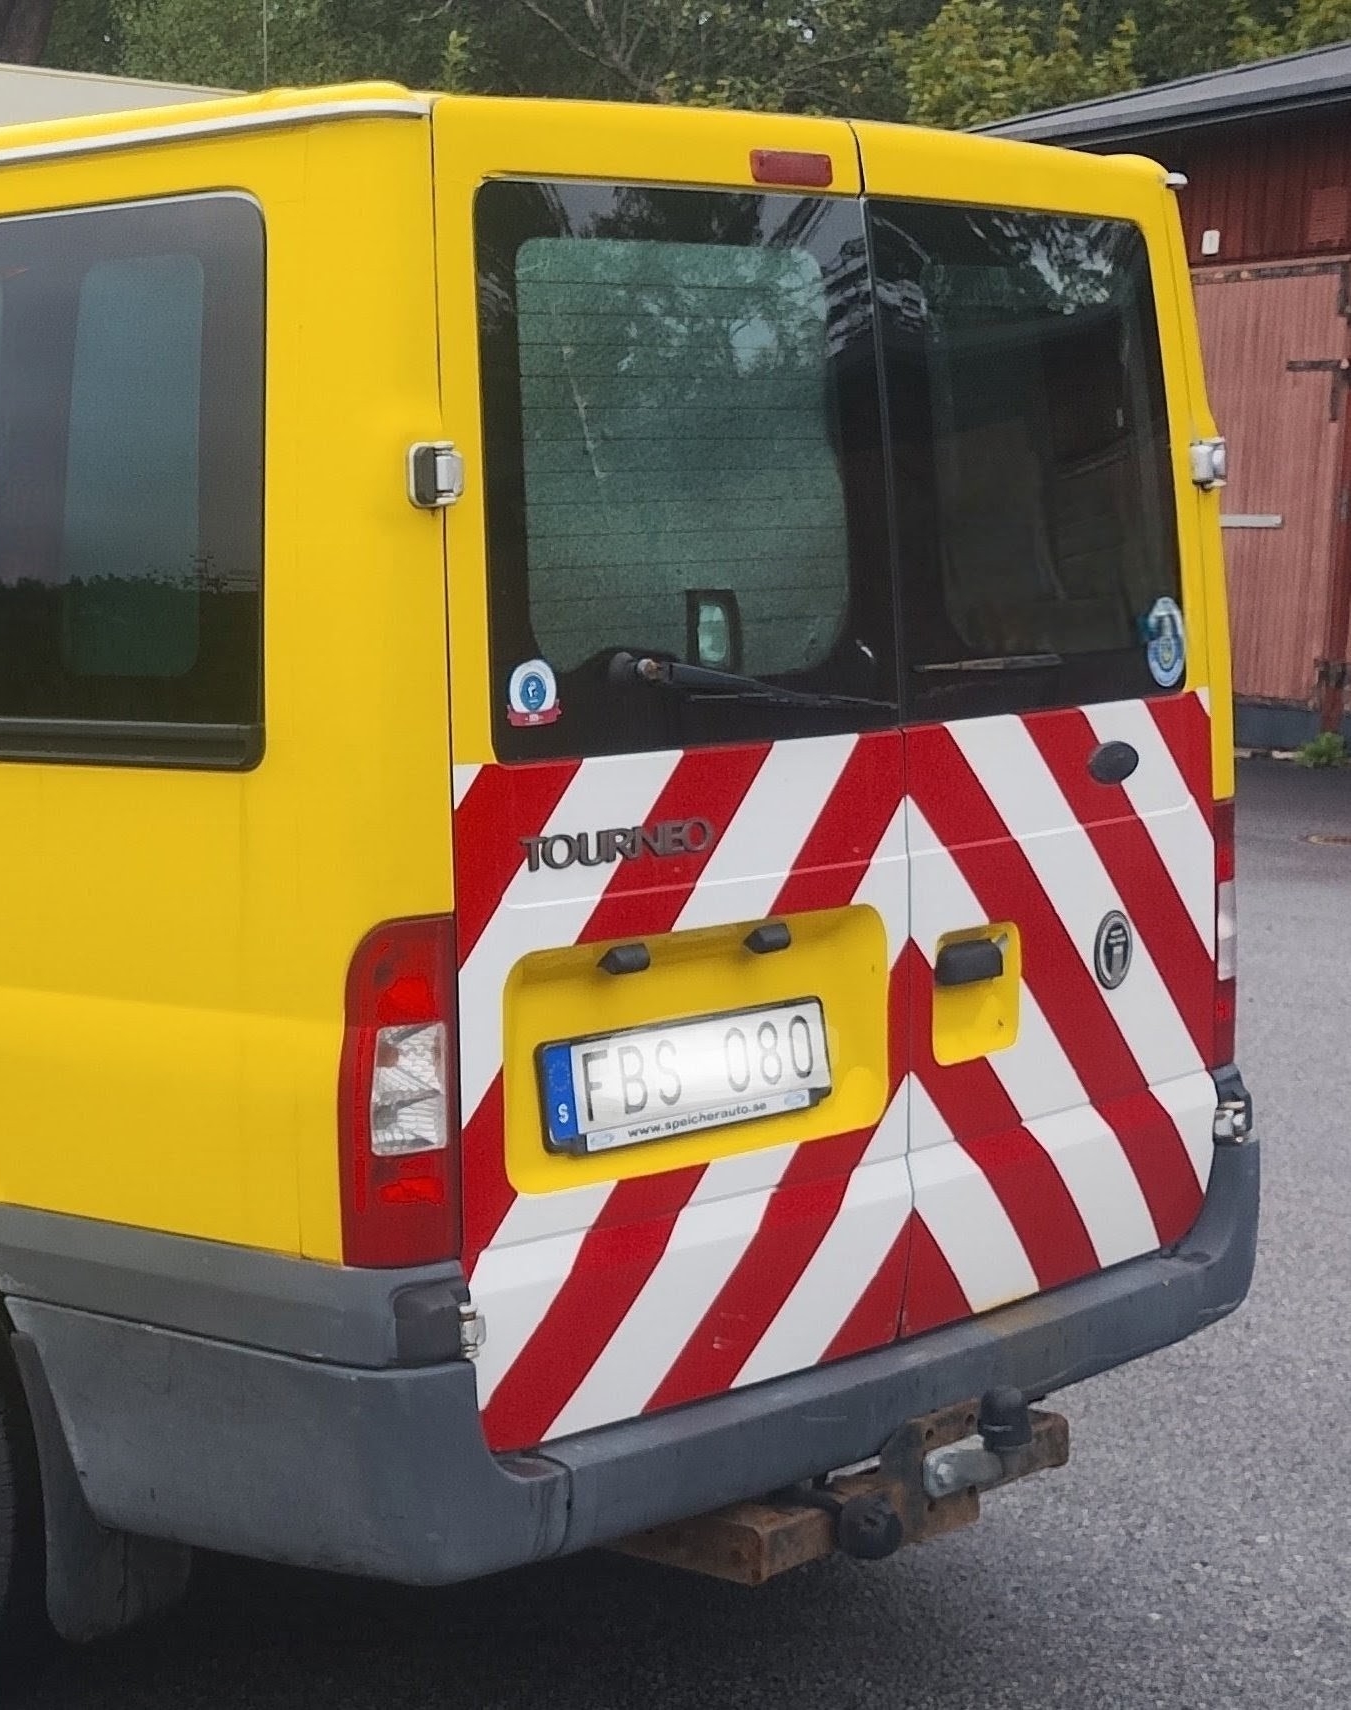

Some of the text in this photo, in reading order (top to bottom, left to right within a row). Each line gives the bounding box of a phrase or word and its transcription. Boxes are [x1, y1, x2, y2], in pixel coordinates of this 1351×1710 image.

[519, 817, 715, 873] TOURNEO
[581, 1014, 814, 1122] FBS 080
[627, 1101, 768, 1139] www.speicherauto.se
